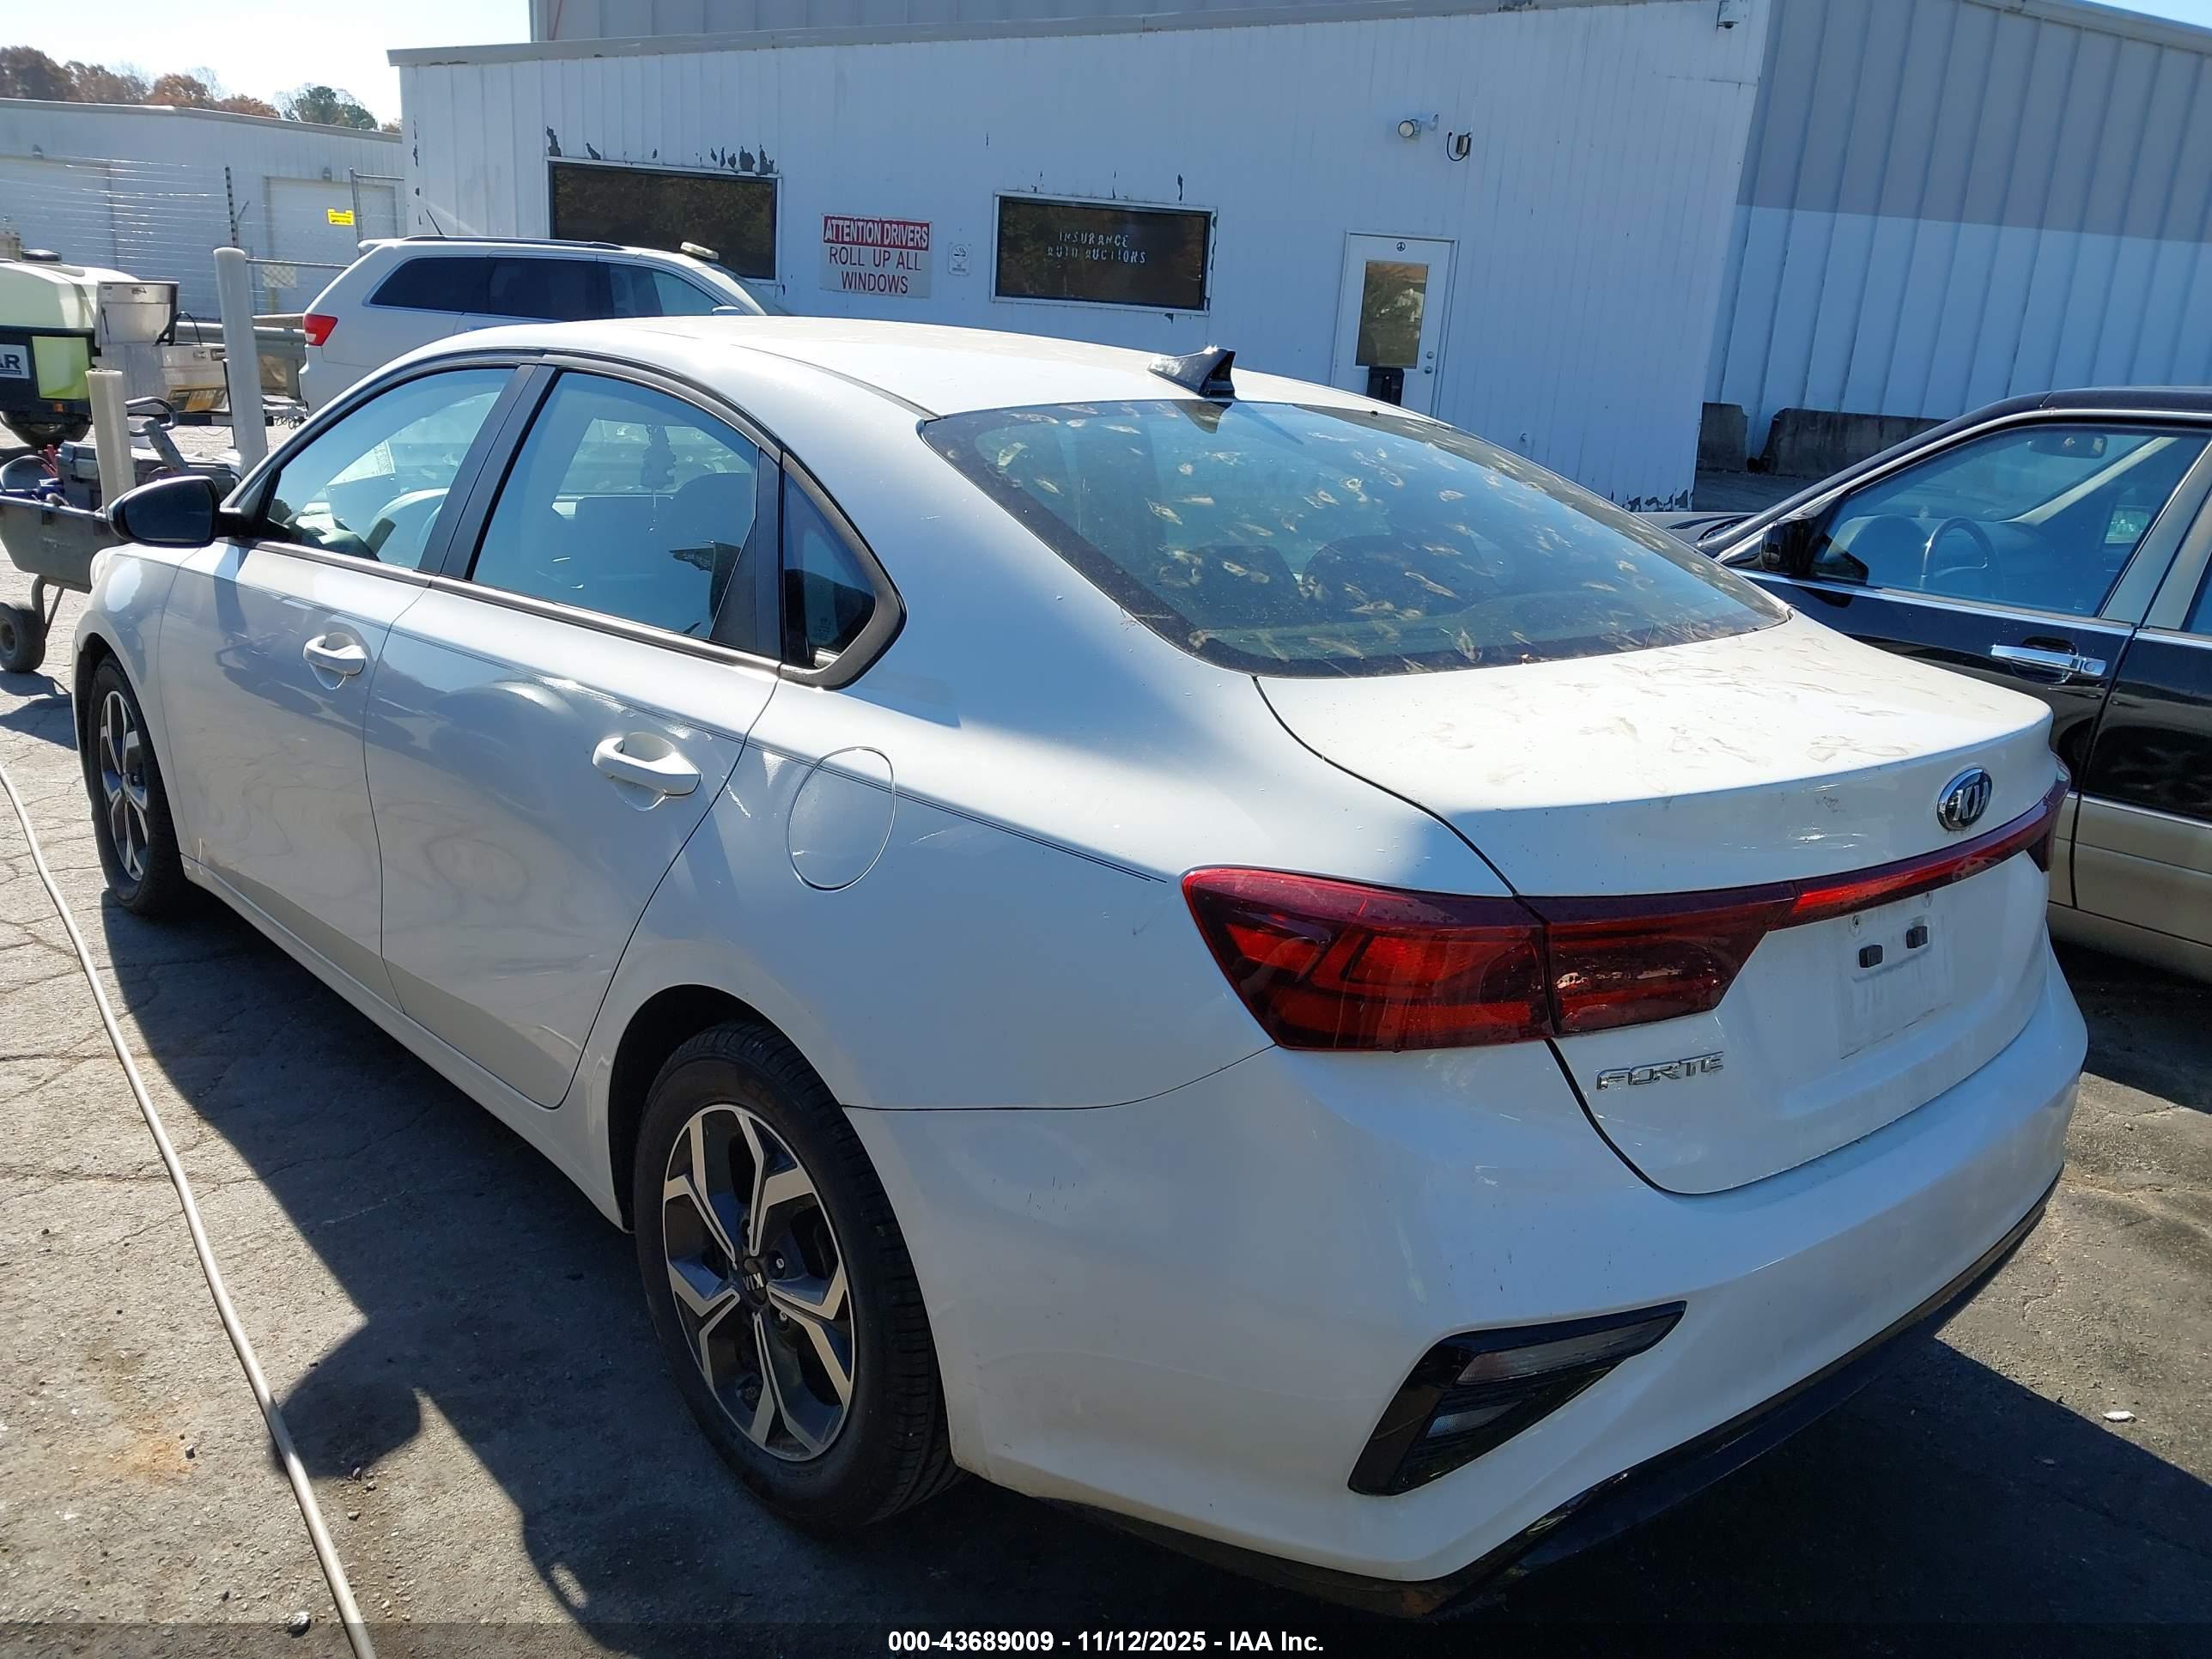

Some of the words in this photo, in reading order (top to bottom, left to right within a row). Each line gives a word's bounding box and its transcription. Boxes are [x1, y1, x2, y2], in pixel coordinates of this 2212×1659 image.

[823, 219, 881, 244] ATTENTION
[884, 223, 929, 247] DRIVERS
[1059, 231, 1128, 248] INSURANCE
[829, 246, 865, 266] ROLL
[873, 249, 890, 268] UP
[896, 252, 921, 271] ALL
[1085, 247, 1146, 264] AUCTIONS
[842, 271, 908, 295] WINDOWS
[1596, 1050, 1725, 1091] FORTE
[742, 1272, 764, 1291] KIA
